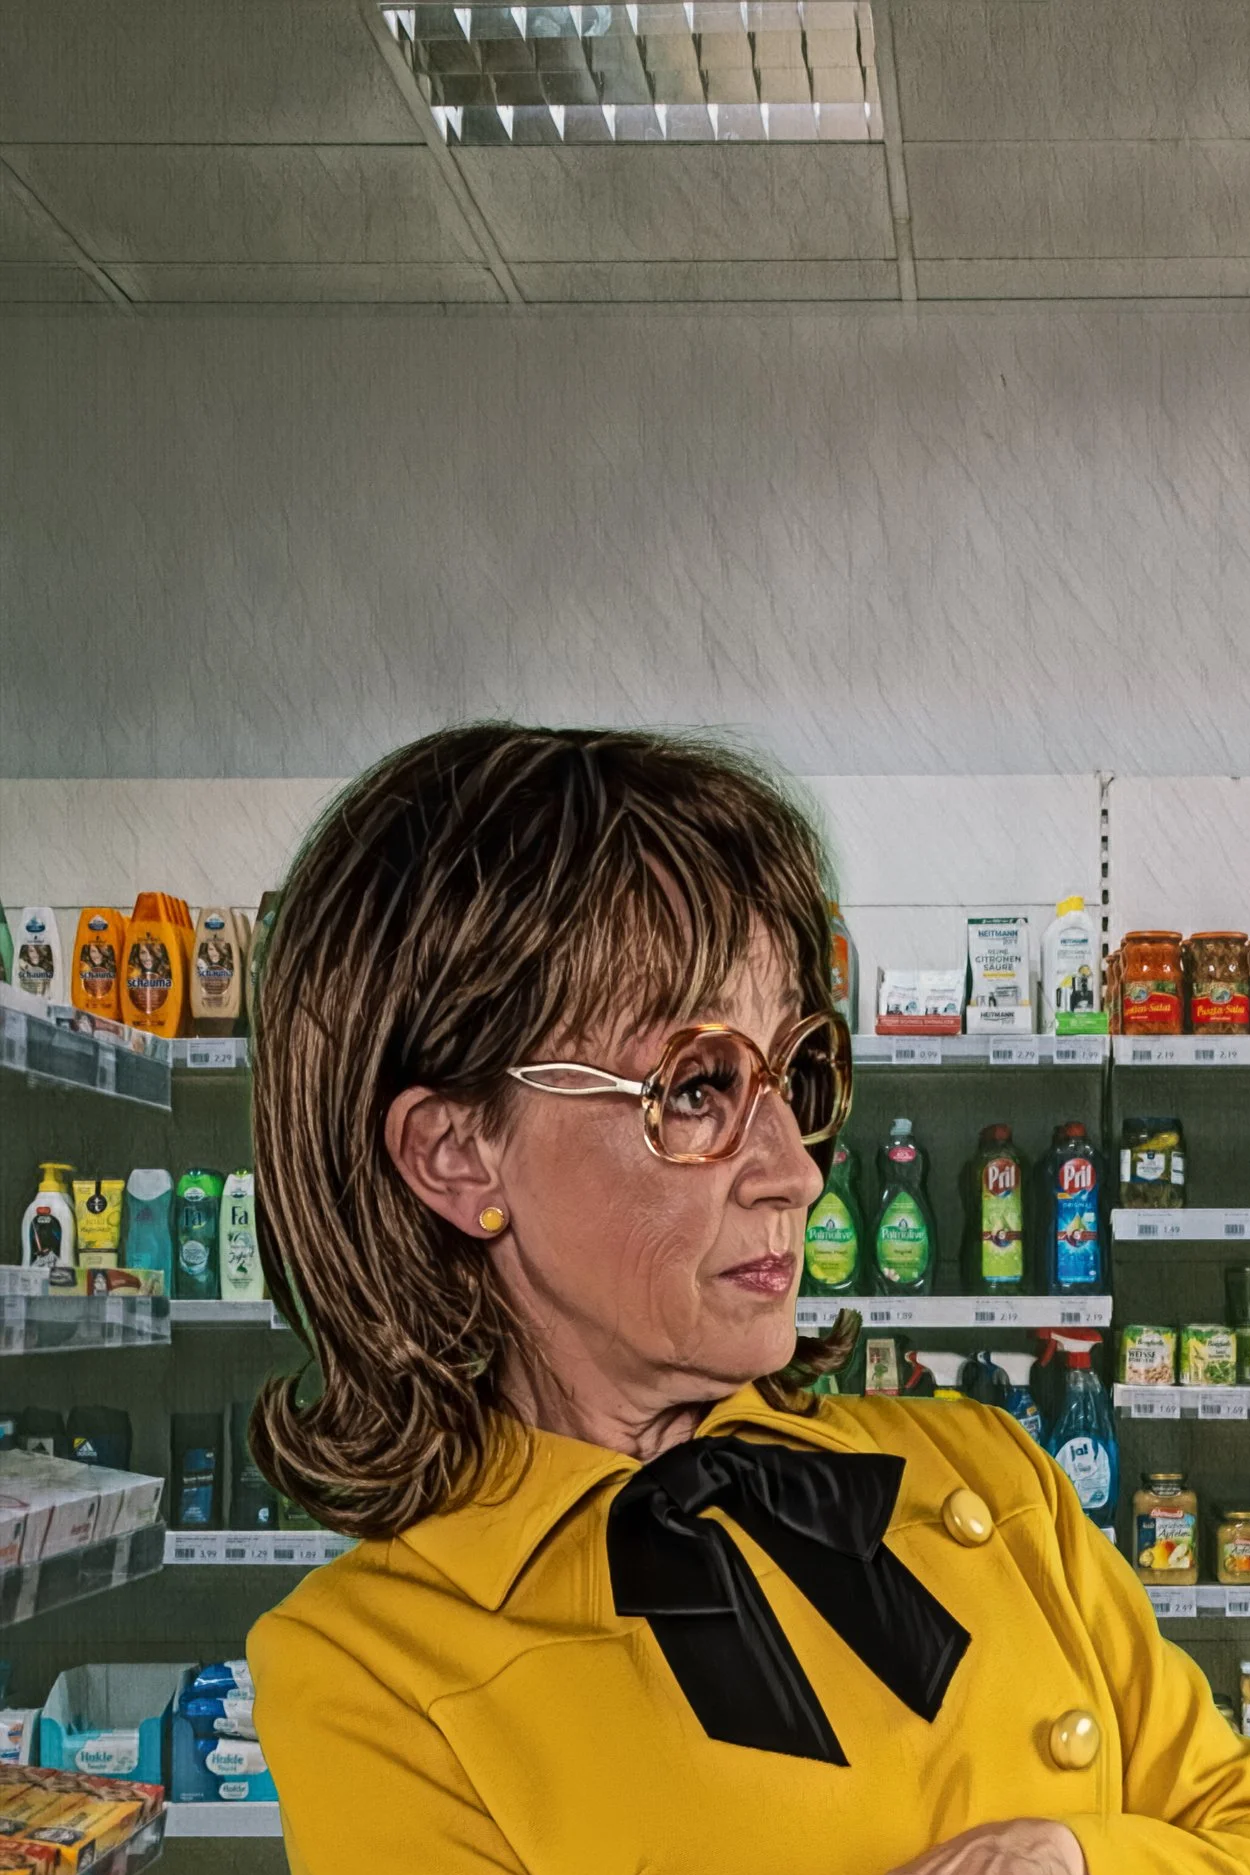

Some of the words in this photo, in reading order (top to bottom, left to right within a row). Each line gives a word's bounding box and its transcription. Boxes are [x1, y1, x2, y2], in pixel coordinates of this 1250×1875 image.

[975, 955, 1022, 964] CITRONEN
[988, 1165, 1015, 1190] Pril
[1063, 1164, 1092, 1190] Pril
[231, 1206, 249, 1226] Fa
[881, 1229, 925, 1240] Palmolive
[1071, 1443, 1088, 1461] ja!
[81, 1752, 113, 1763] Hakle
[211, 1753, 245, 1764] Hakle
